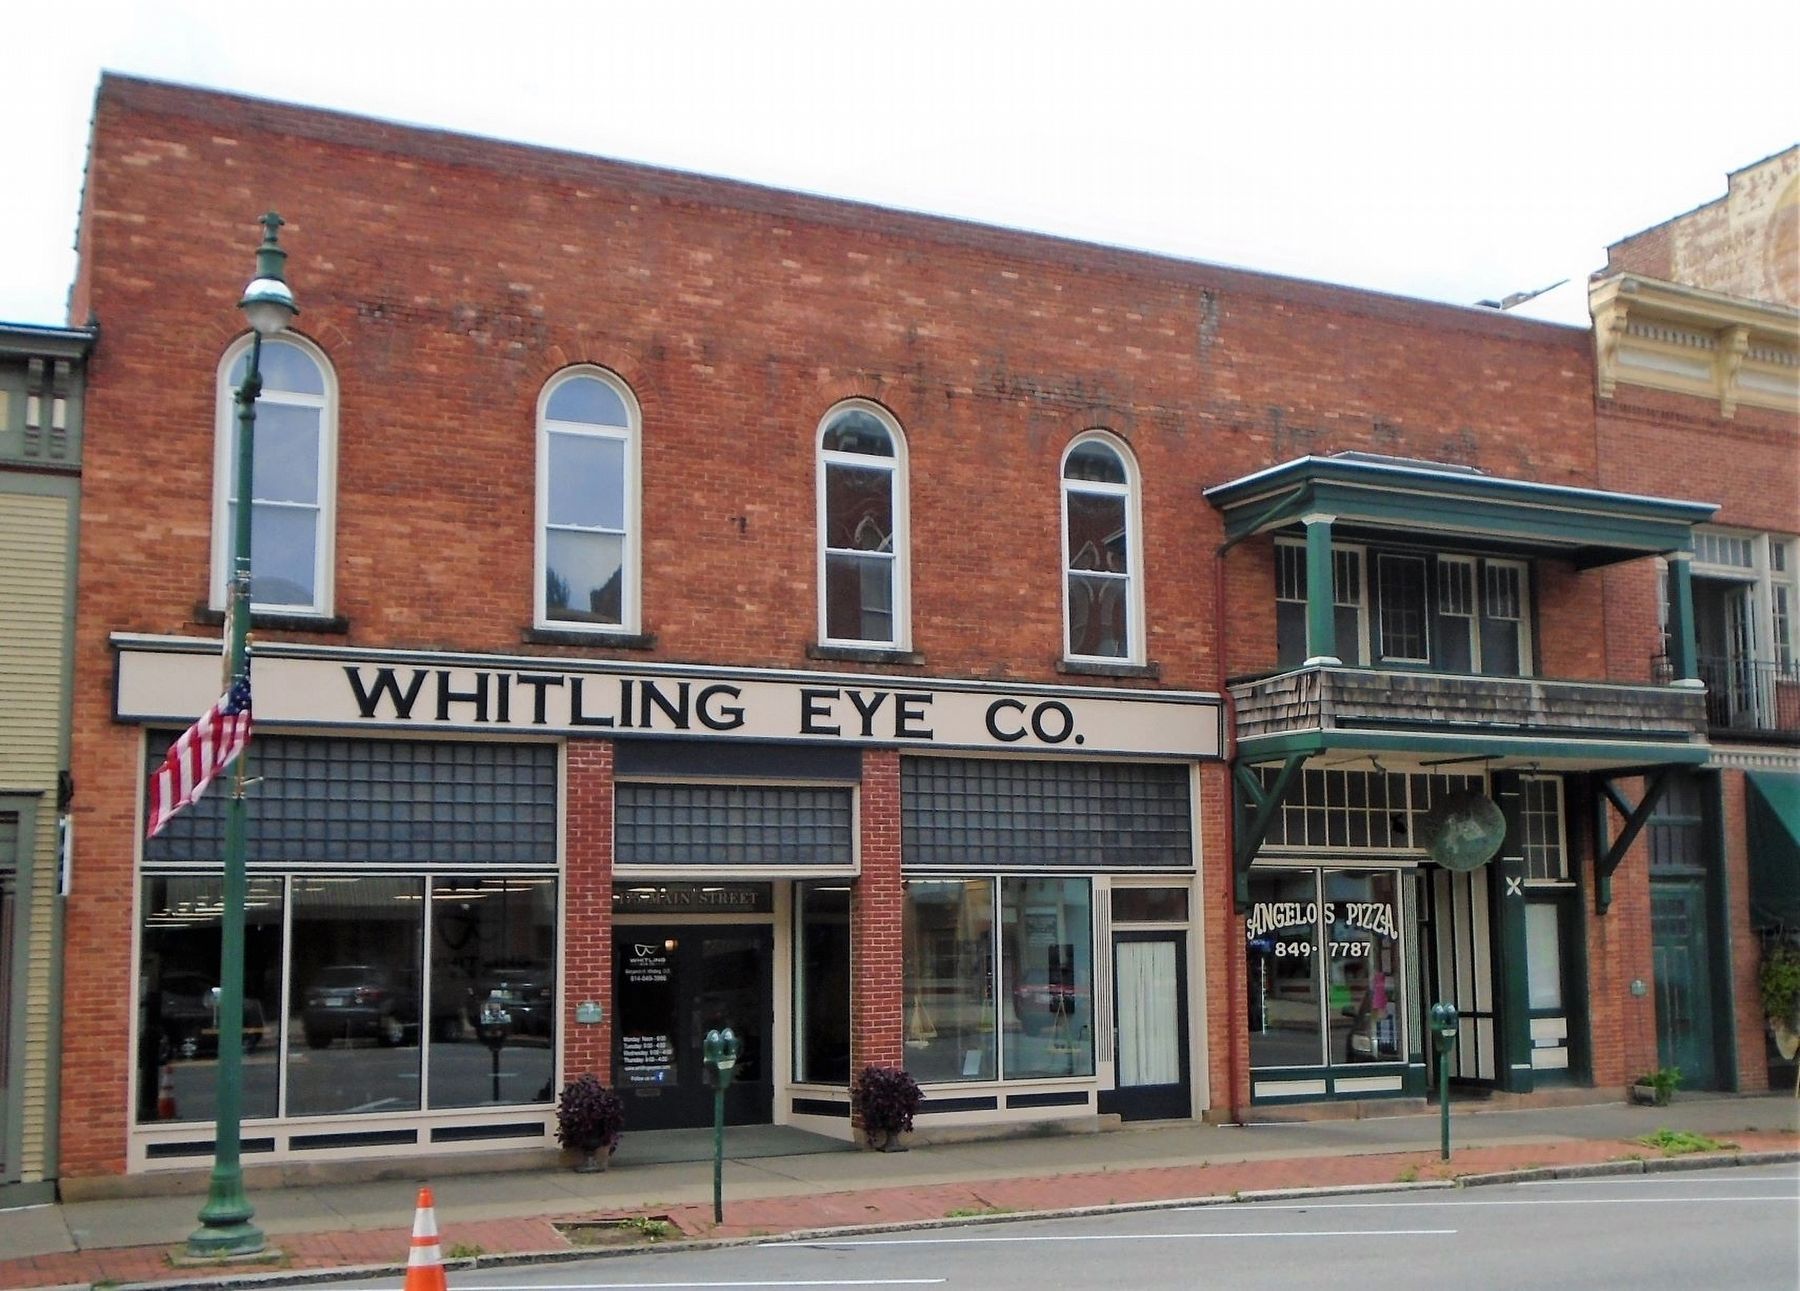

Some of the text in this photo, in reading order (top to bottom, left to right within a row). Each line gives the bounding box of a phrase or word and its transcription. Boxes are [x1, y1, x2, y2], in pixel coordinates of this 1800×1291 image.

[343, 665, 1085, 744] WHITLING EYE CO.
[649, 892, 690, 905] MAIN
[699, 892, 758, 905] STREET
[1346, 903, 1398, 940] PIZZA
[1328, 942, 1371, 957] 7787
